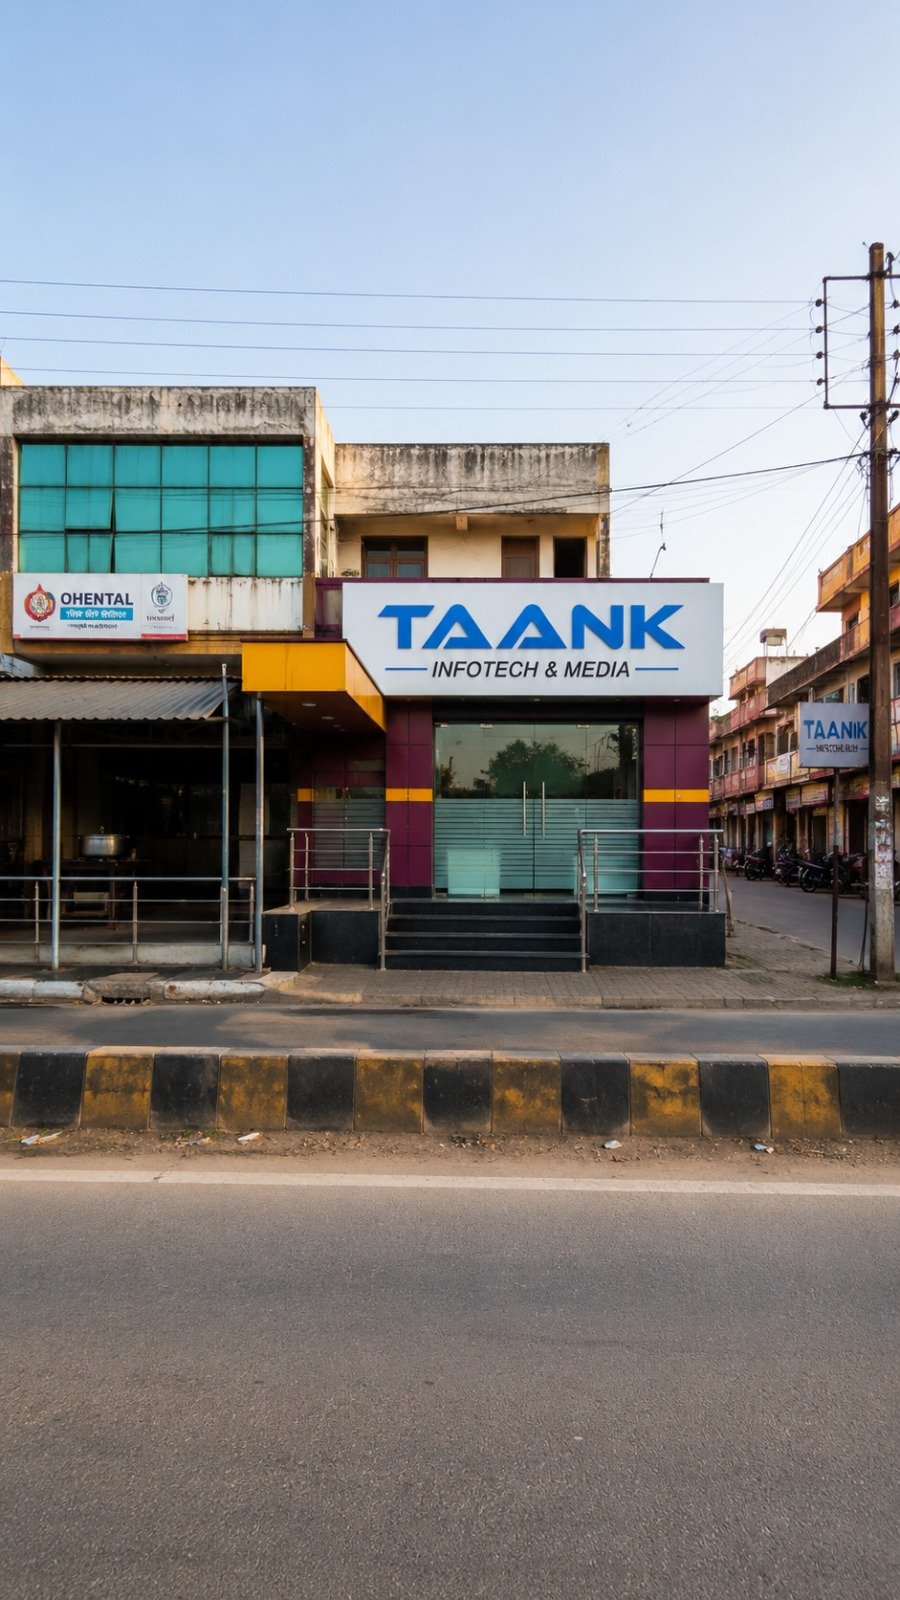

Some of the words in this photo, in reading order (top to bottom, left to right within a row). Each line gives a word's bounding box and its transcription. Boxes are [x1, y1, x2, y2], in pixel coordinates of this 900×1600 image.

[60, 592, 134, 606] OHENTAL
[377, 603, 686, 650] TAANK
[431, 660, 540, 678] INFOTECH
[544, 660, 558, 678] &
[563, 660, 630, 678] MEDIA
